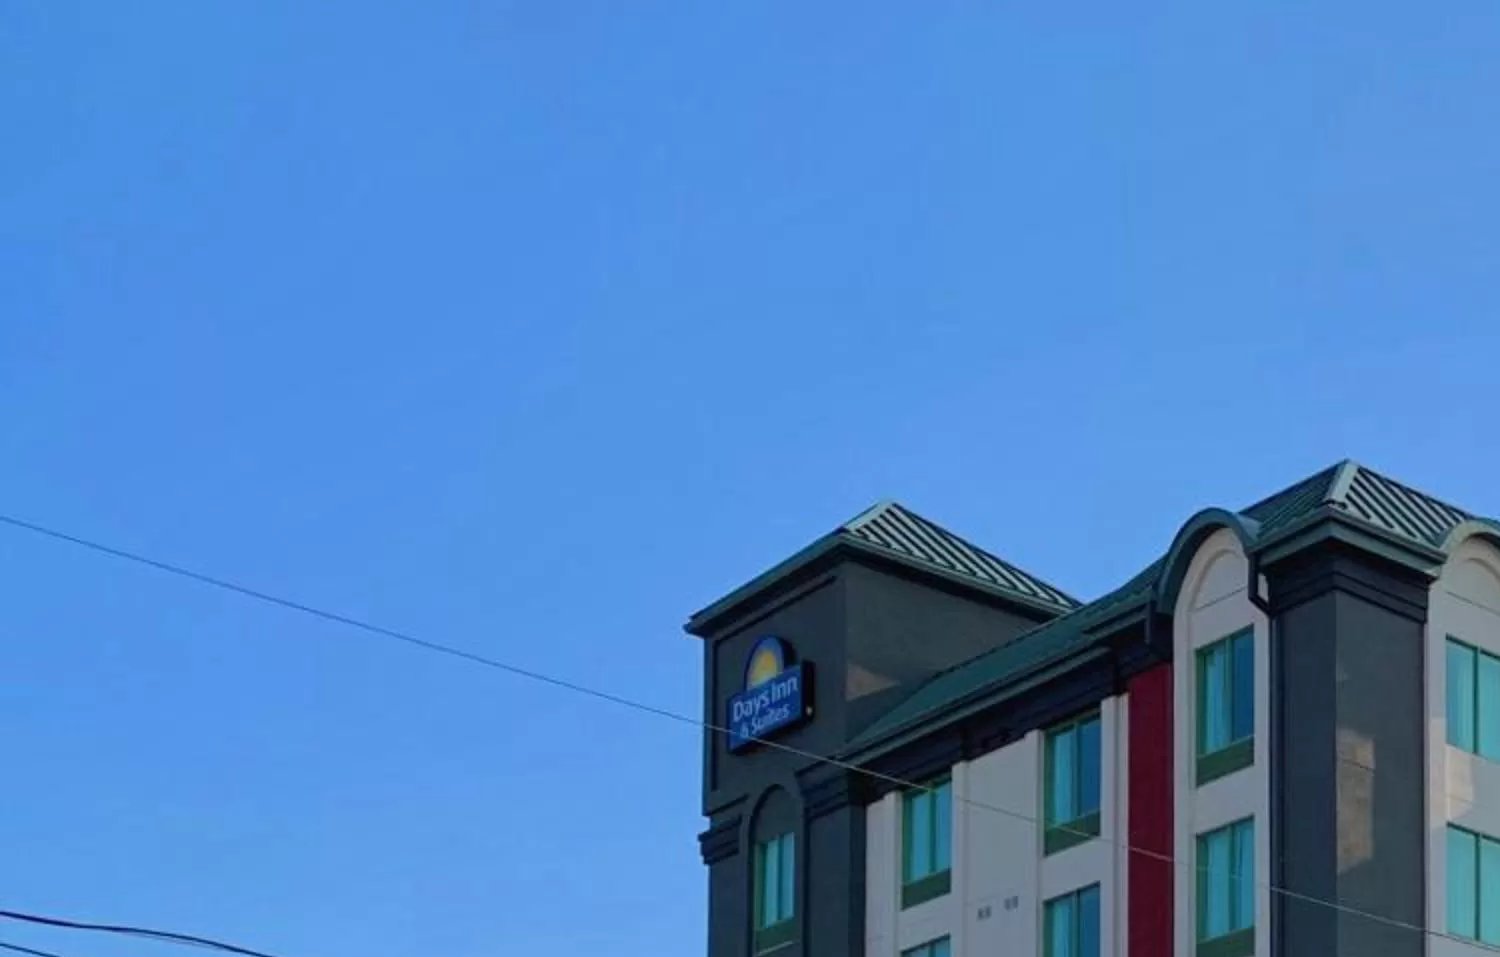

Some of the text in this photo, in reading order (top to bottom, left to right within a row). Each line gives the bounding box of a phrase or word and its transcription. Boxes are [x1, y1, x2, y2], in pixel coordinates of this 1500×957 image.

[733, 677, 798, 722] Days Inn
[751, 703, 790, 735] Suites
